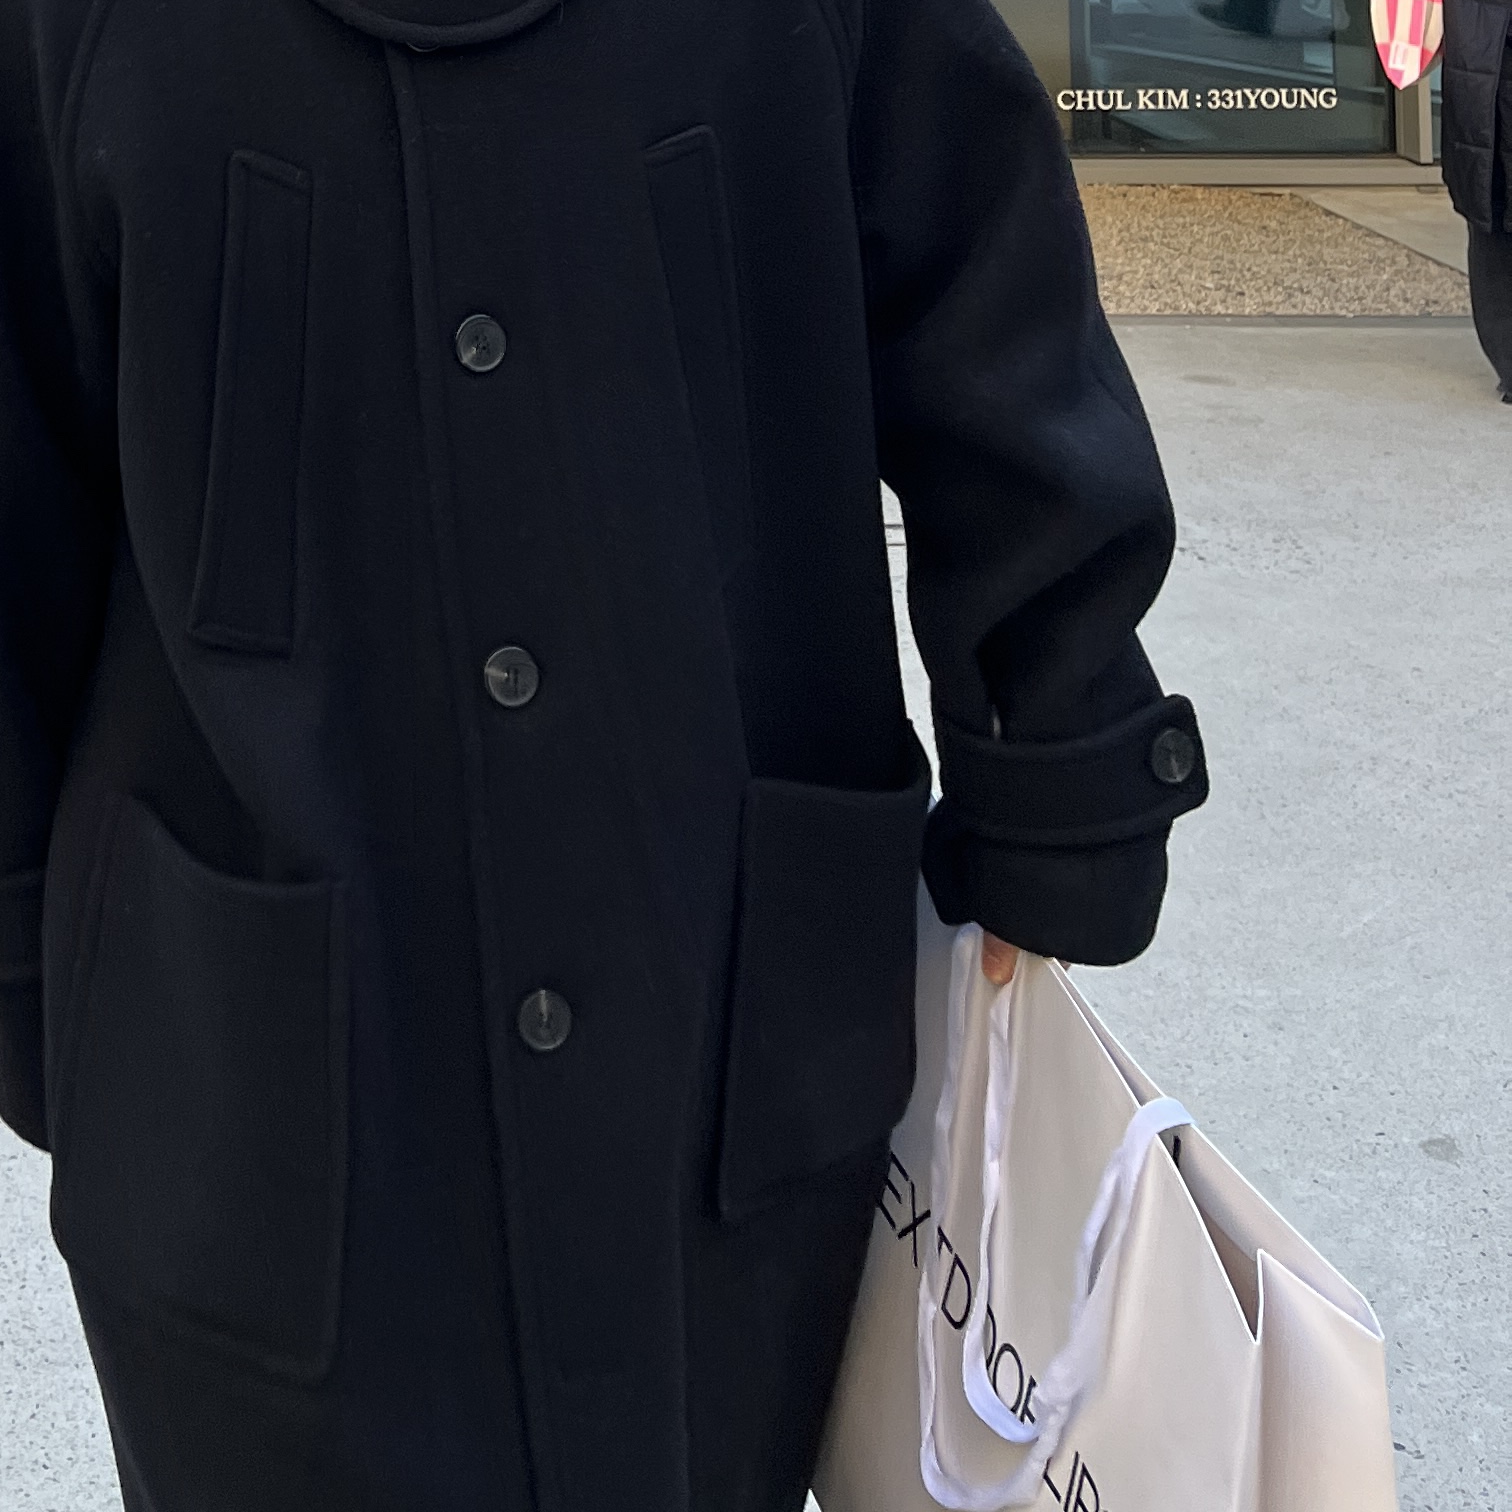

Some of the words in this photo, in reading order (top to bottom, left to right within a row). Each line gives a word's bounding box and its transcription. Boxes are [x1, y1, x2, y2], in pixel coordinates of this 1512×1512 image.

[1057, 89, 1132, 110] CHUL
[1138, 89, 1189, 110] KIM
[1207, 88, 1338, 109] 331YOUNG
